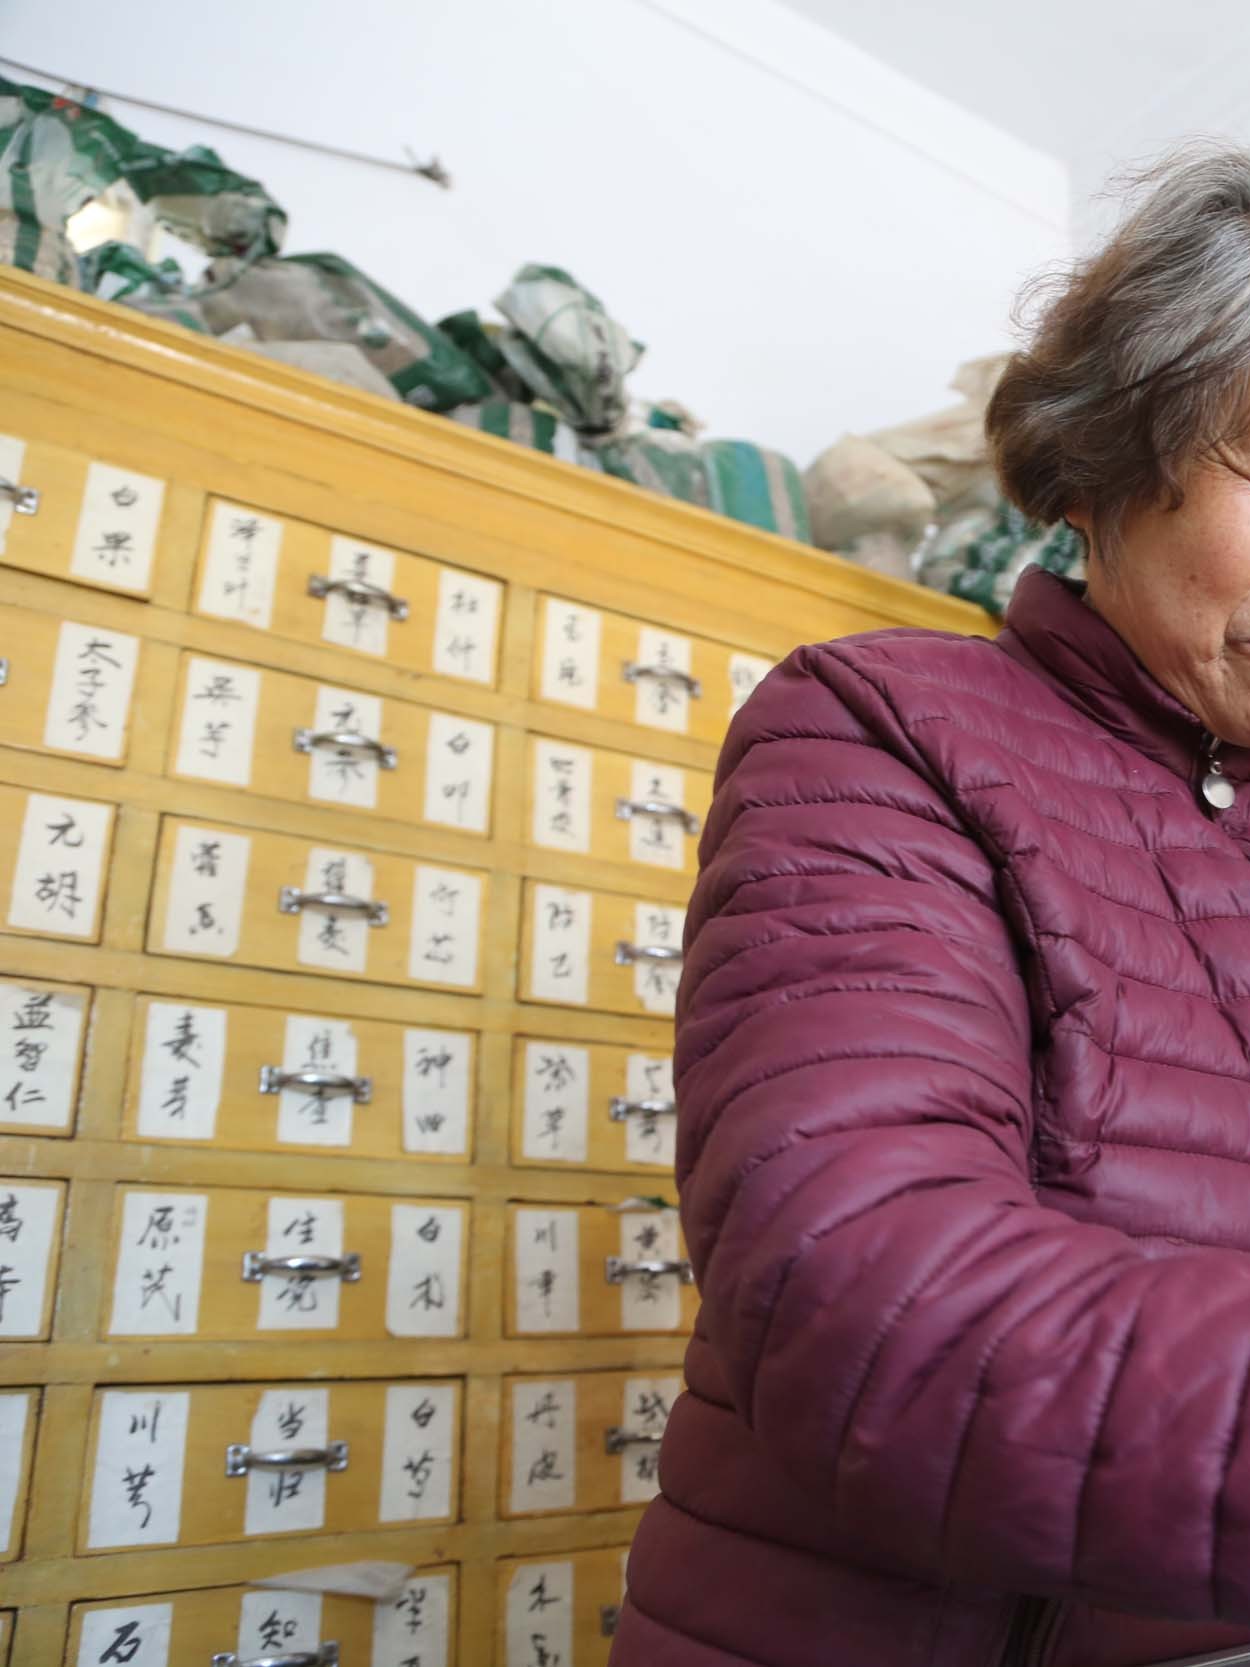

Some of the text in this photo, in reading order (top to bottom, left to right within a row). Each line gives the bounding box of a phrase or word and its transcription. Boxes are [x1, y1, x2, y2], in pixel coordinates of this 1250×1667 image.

[34, 813, 84, 919] 元胡
[3, 993, 55, 1111] 益智仁
[268, 1401, 305, 1508] 当归
[258, 1609, 298, 1651] 知
